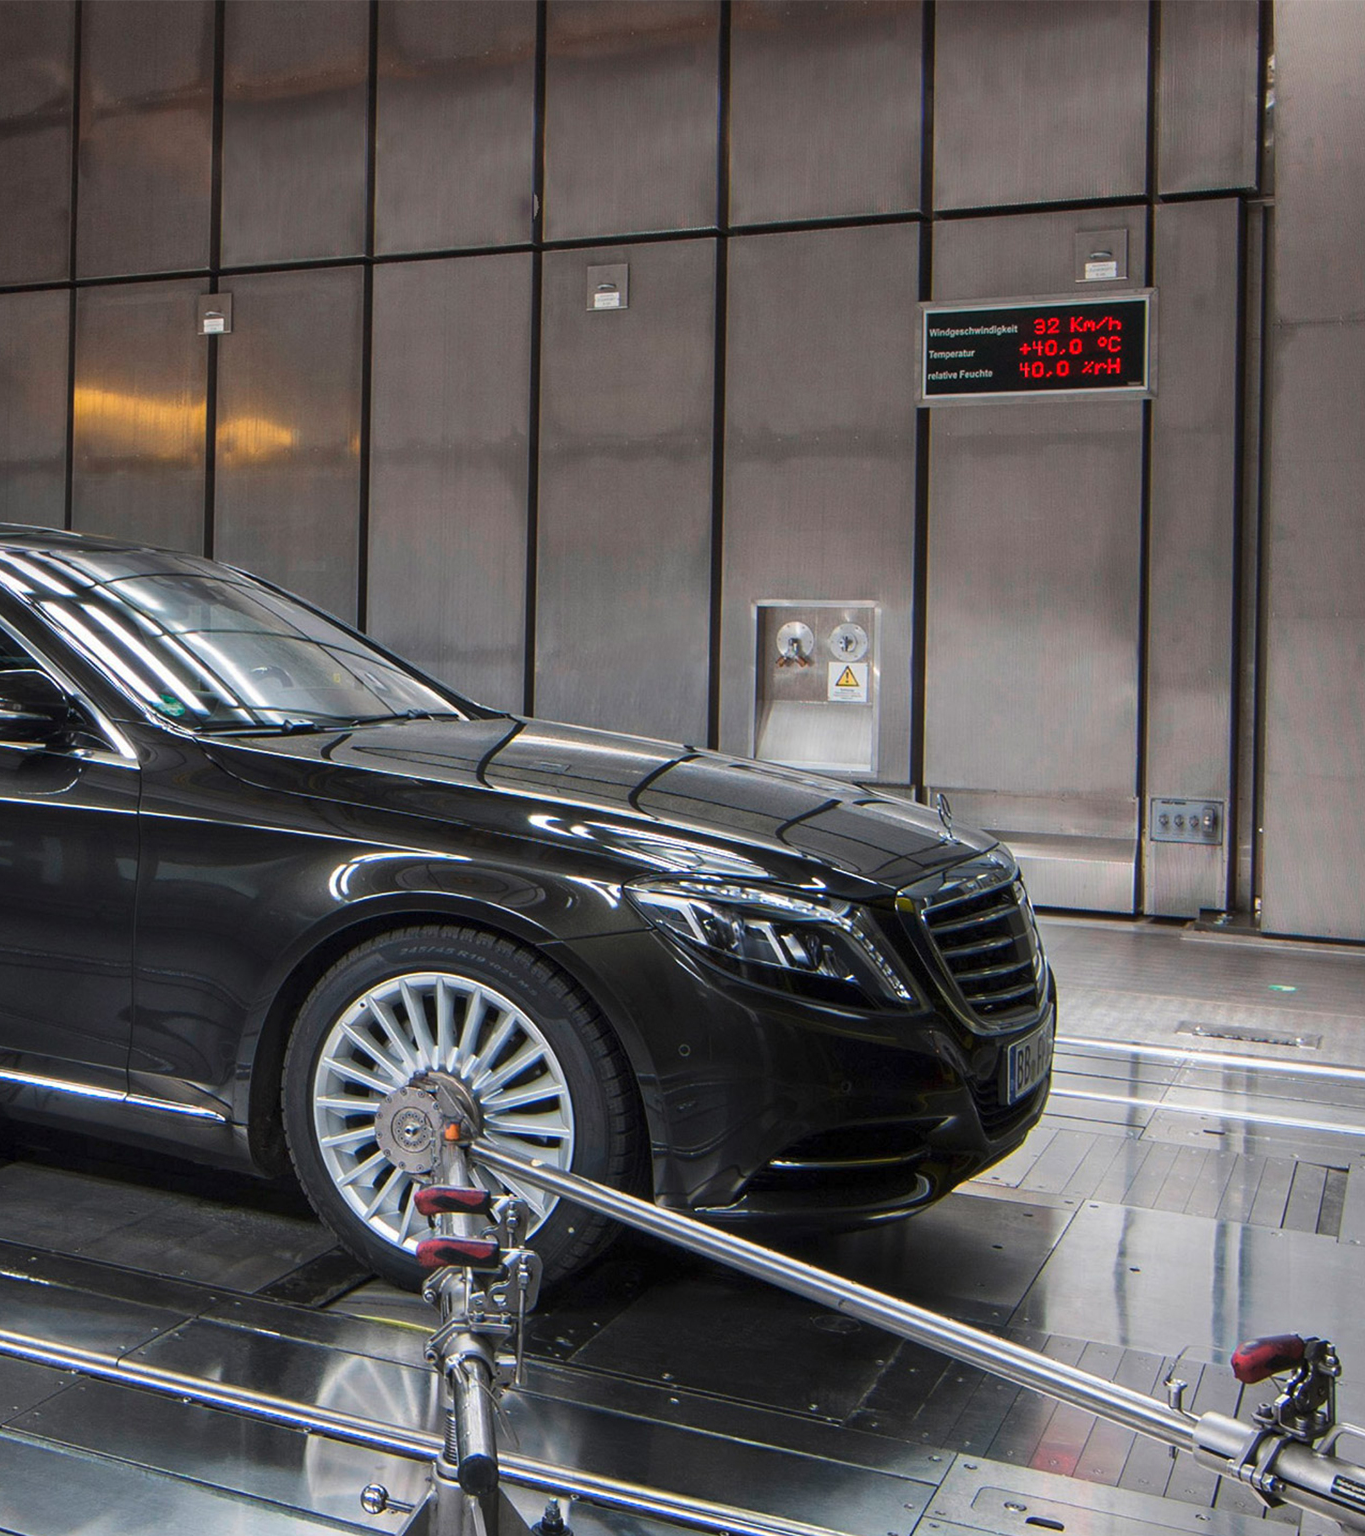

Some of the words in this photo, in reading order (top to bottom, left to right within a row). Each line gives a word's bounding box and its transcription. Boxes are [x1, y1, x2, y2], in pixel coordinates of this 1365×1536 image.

[929, 324, 1018, 338] Windgeschwindigkeit
[1033, 317, 1060, 335] 32
[1070, 316, 1122, 333] Km/h
[928, 349, 976, 360] Temperatur
[1097, 335, 1122, 353] °C
[927, 371, 958, 380] relative
[959, 369, 994, 379] Feuchte
[1081, 357, 1121, 375] %rH
